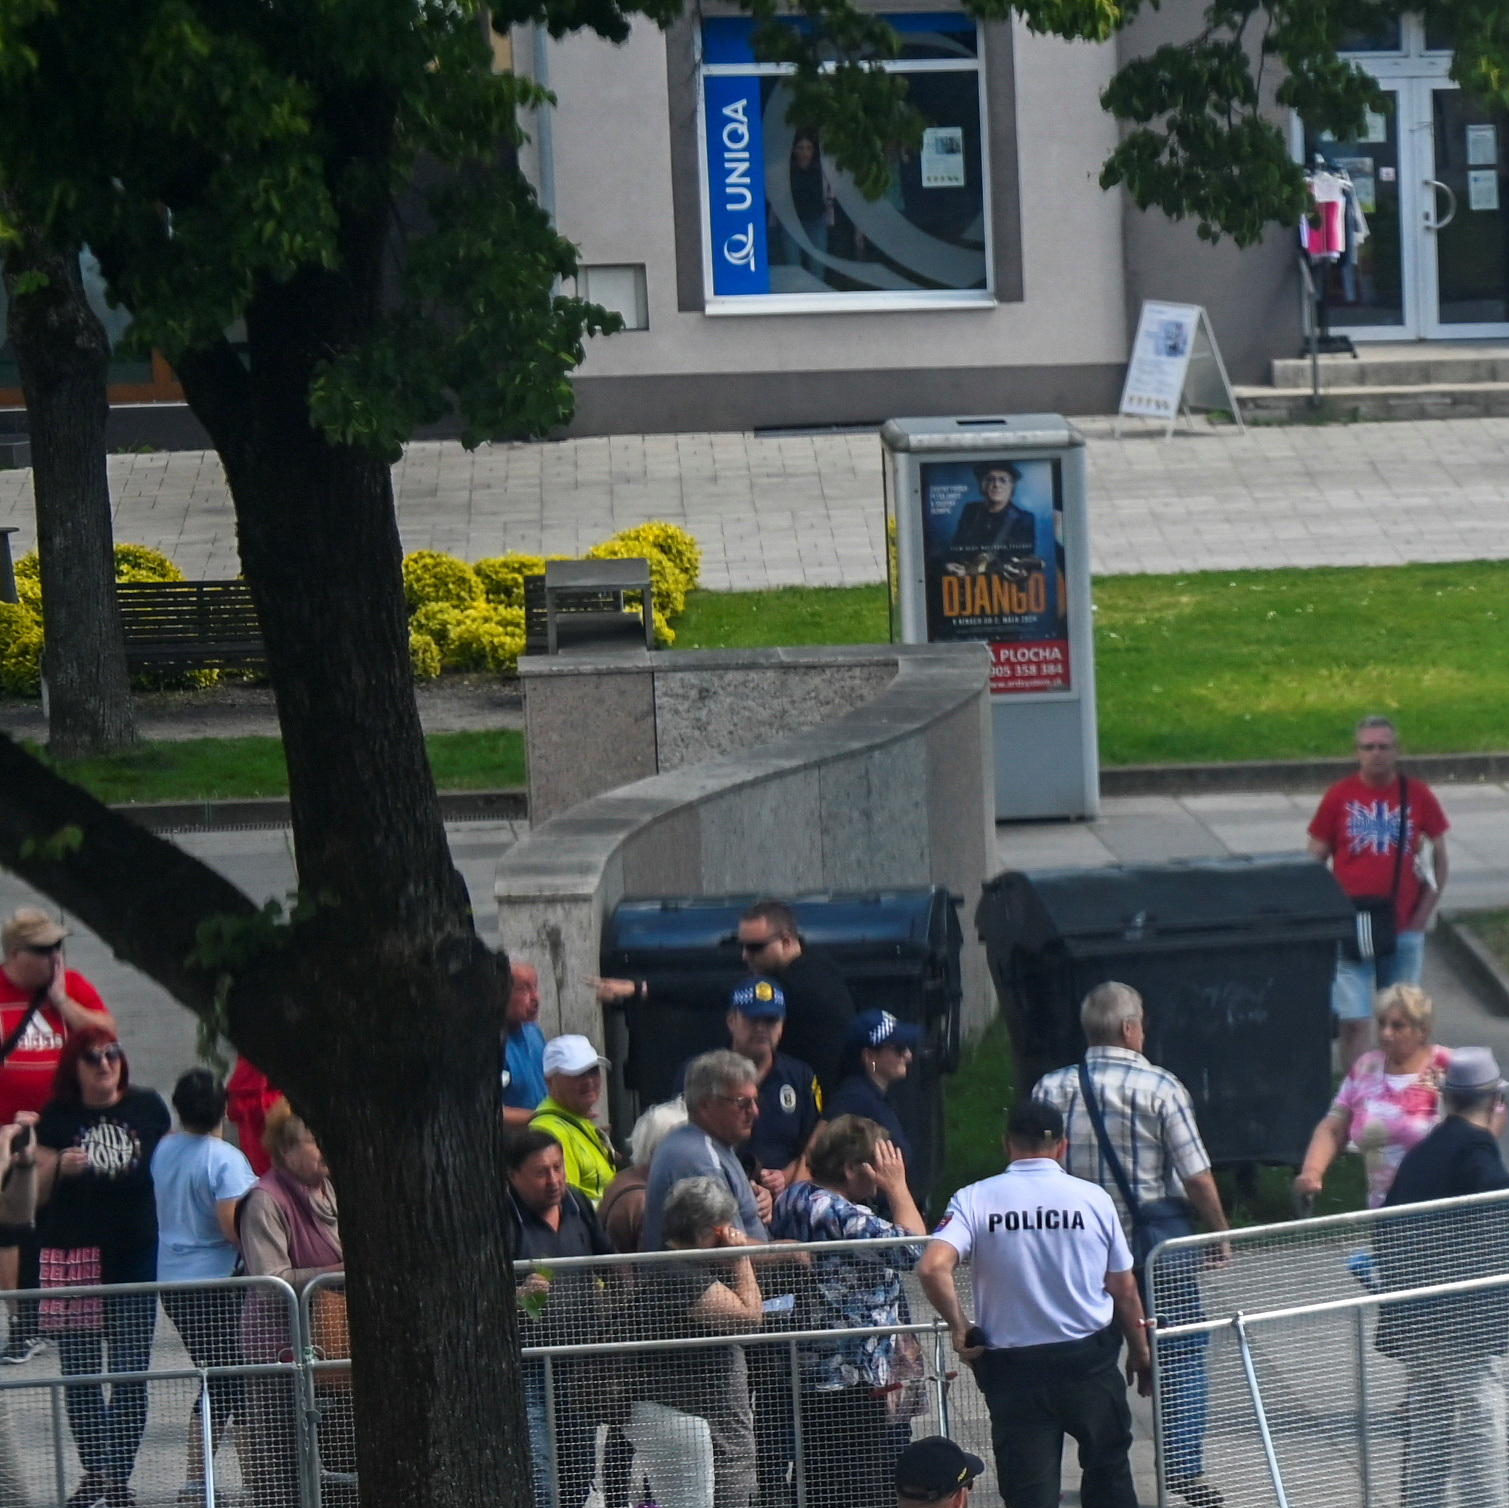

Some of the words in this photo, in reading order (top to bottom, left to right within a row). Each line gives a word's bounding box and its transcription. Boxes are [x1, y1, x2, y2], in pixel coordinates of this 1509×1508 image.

[722, 98, 752, 211] UNIQA
[942, 572, 1046, 617] DJANGO
[1000, 646, 1062, 663] PLOCHA
[988, 1205, 1085, 1233] POLÍCIA
